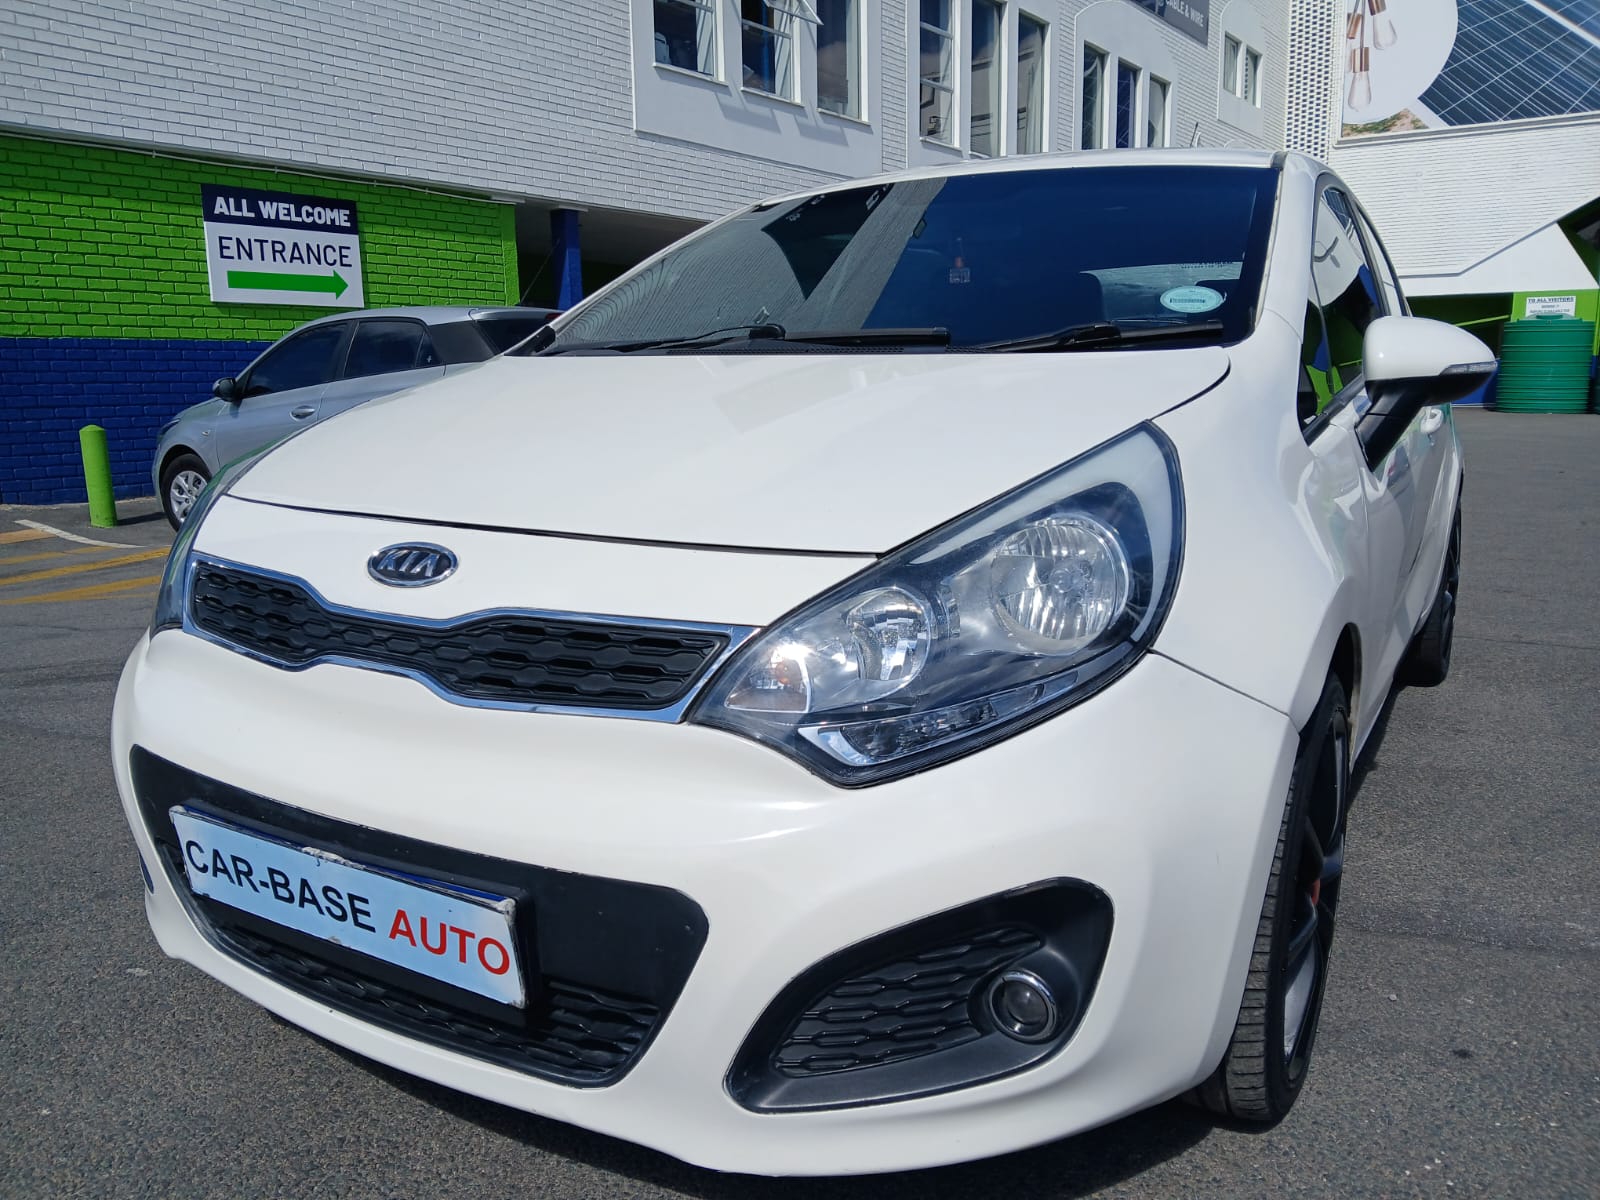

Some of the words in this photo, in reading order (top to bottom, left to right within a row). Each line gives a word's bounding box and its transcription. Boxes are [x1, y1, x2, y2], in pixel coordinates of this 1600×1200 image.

[1190, 7, 1204, 27] WIRE
[214, 196, 255, 218] ALL
[258, 200, 351, 227] WELCOME
[218, 236, 352, 267] ENTRANCE
[377, 549, 441, 577] KIA
[185, 840, 376, 933] CAR-BASE
[389, 909, 511, 976] AUTO
